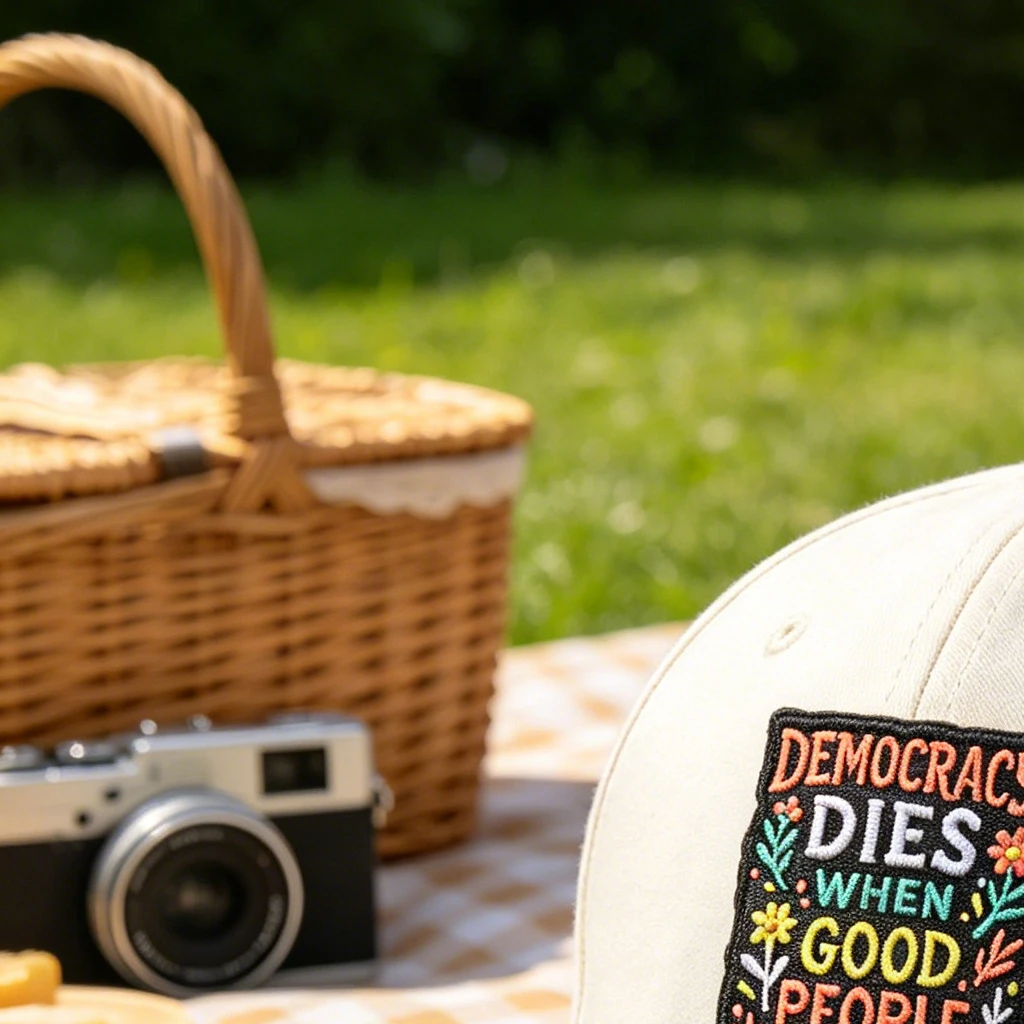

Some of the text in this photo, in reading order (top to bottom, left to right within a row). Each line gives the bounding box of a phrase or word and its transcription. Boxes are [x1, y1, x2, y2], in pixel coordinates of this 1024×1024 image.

[804, 795, 981, 876] DIES
[816, 869, 954, 921] WHEN
[801, 917, 961, 987] GOOD
